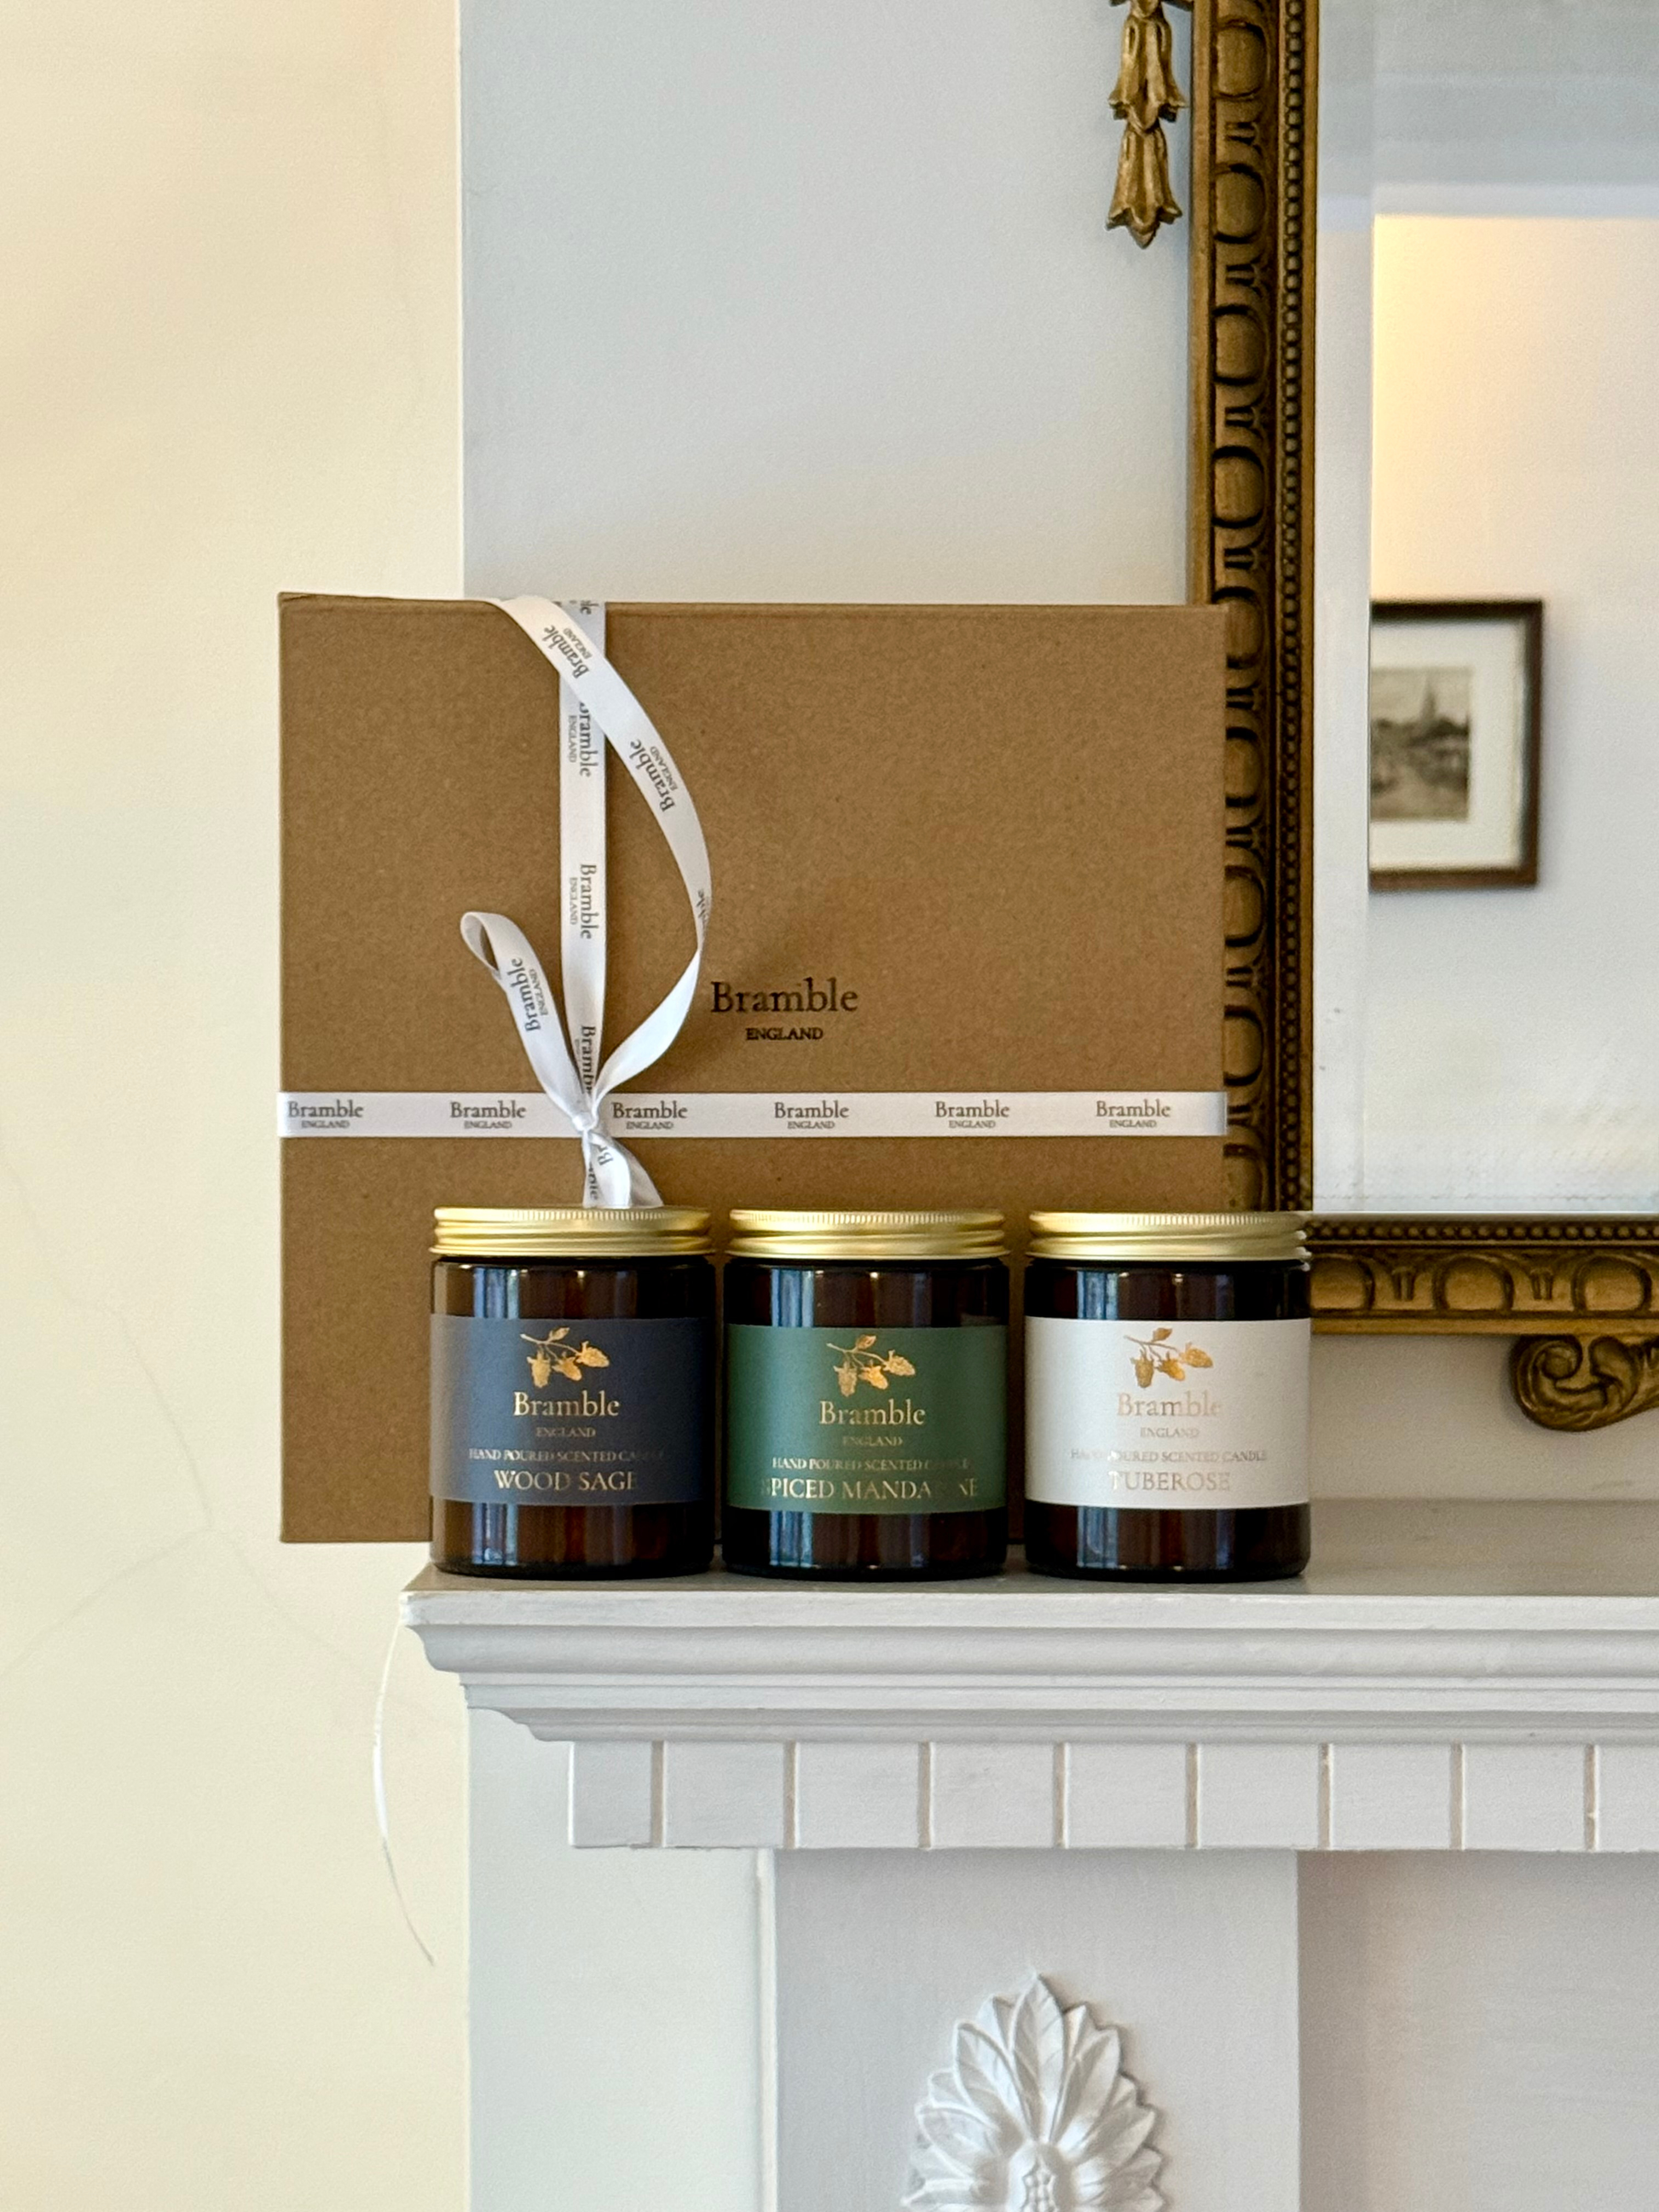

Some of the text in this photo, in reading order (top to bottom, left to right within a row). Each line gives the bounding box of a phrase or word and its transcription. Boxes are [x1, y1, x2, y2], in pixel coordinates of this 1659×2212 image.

[542, 625, 590, 679] Bramble
[563, 627, 592, 660] ENGLAND
[568, 715, 577, 763] ENGLAND
[629, 738, 675, 812] Bramble
[650, 746, 678, 791] ENGLAND
[569, 877, 578, 925] ENGLAND
[581, 863, 599, 939] Bramble
[506, 958, 541, 1031] Bramble
[529, 968, 548, 1016] ENGLAND
[711, 977, 858, 1013] Bramble
[745, 1027, 824, 1040] ENGLAND
[287, 1100, 364, 1118] Bramble
[450, 1100, 526, 1118] Bramble
[611, 1100, 688, 1119] Bramble
[774, 1100, 850, 1118] Bramble
[934, 1100, 1009, 1118] Bramble
[1096, 1099, 1171, 1118] Bramble
[301, 1120, 350, 1129] ENGLAND
[464, 1120, 512, 1129] ENGLAND
[626, 1121, 673, 1129] ENGLAND
[787, 1121, 835, 1129] ENGLAND
[949, 1120, 996, 1129] ENGLAND
[1109, 1119, 1157, 1128] ENGLAND
[513, 1390, 620, 1417] Bramble
[819, 1398, 926, 1425] Bramble
[1116, 1389, 1222, 1417] Bramble
[469, 1448, 501, 1460] HAND
[557, 1451, 616, 1463] SCENTED
[772, 1457, 806, 1469] HAND
[494, 1470, 638, 1492] WOOD SAGE
[841, 1478, 978, 1499] MANDANE
[1108, 1470, 1230, 1492] TUBEROSE
